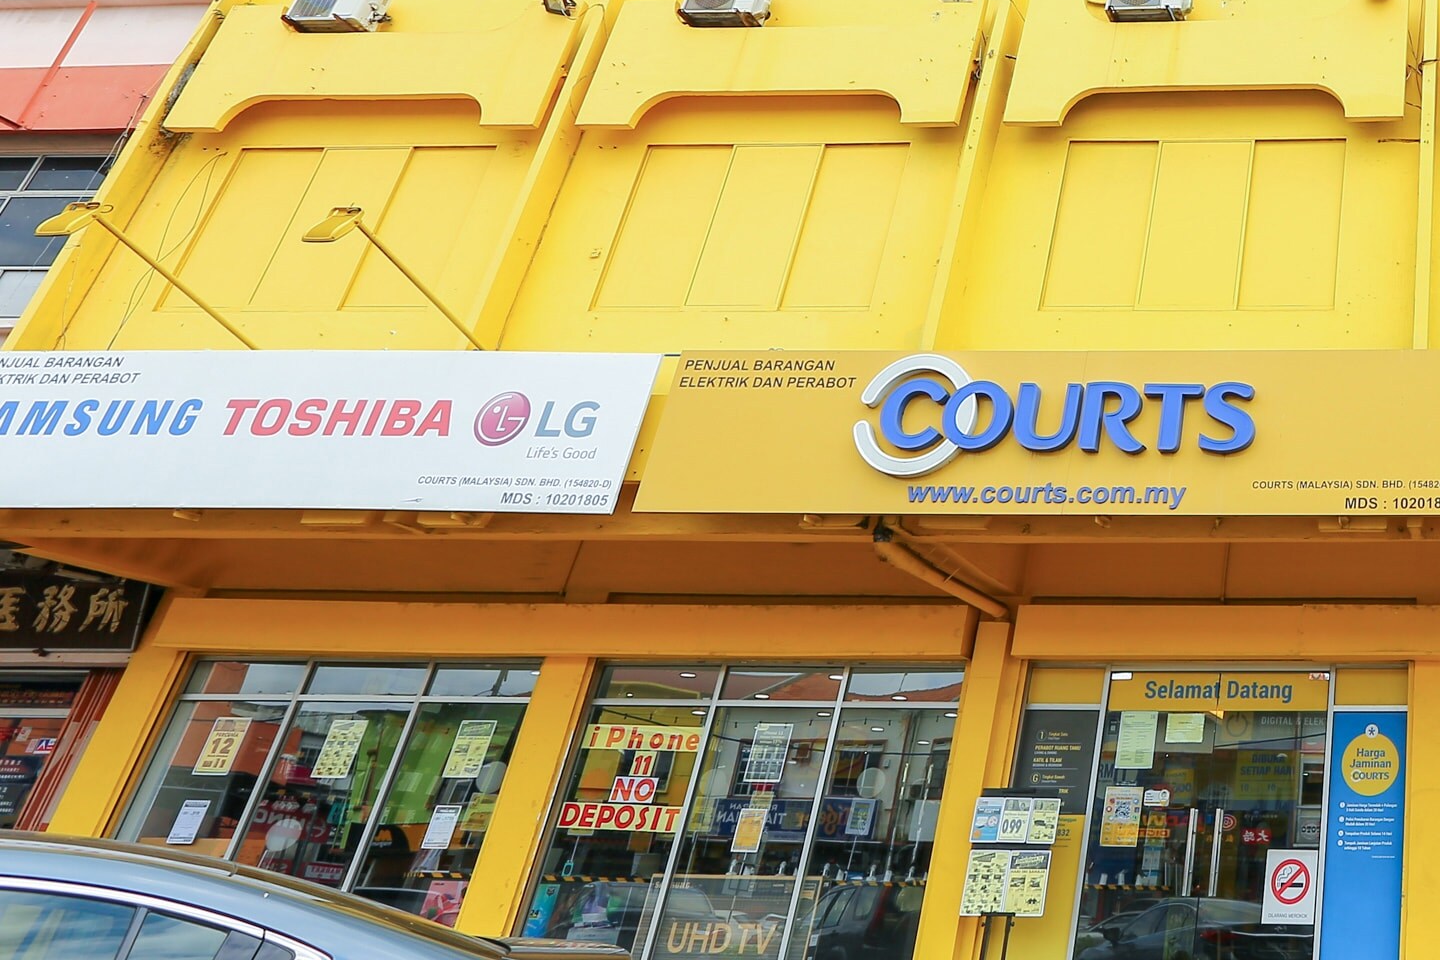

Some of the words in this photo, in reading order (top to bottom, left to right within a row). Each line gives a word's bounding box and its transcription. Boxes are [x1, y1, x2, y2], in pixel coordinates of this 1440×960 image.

[44, 357, 125, 368] BARANGAN
[685, 360, 749, 371] PENJUAL
[753, 360, 835, 371] BARANGAN
[39, 373, 71, 384] DAN
[71, 372, 141, 384] PERABOT
[679, 376, 750, 388] ELEKTRIK
[753, 377, 783, 388] DAN
[786, 377, 857, 388] PERABOT
[223, 399, 453, 436] TOSHIBA
[534, 400, 600, 438] LG
[878, 377, 1256, 455] COURTS
[562, 447, 598, 460] Good
[418, 476, 457, 486] COURTS
[459, 476, 513, 487] (MALAYSIA)
[515, 477, 536, 487] SDN.
[539, 478, 561, 487] BHD.
[564, 479, 612, 489] (154820-D)
[1252, 480, 1293, 489] COURTS
[1296, 480, 1353, 490] (MALAYSIA)
[1355, 480, 1379, 489] SDN.
[1382, 480, 1405, 489] BHD.
[500, 492, 532, 505] MDS
[546, 493, 609, 506] 10201805
[907, 482, 1187, 510] www.courts.com.my
[1344, 497, 1378, 509] MDS
[1144, 680, 1220, 699] Selamat
[1227, 680, 1292, 703] Datang
[211, 738, 235, 754] 12
[1356, 748, 1385, 760] Harga
[633, 755, 652, 775] 11
[1350, 758, 1391, 769] Jaminan
[1352, 771, 1389, 781] COURTS
[611, 778, 655, 801] NO
[559, 804, 681, 831] DEPOSIT
[667, 921, 733, 954] UHD
[738, 923, 778, 954] TV
